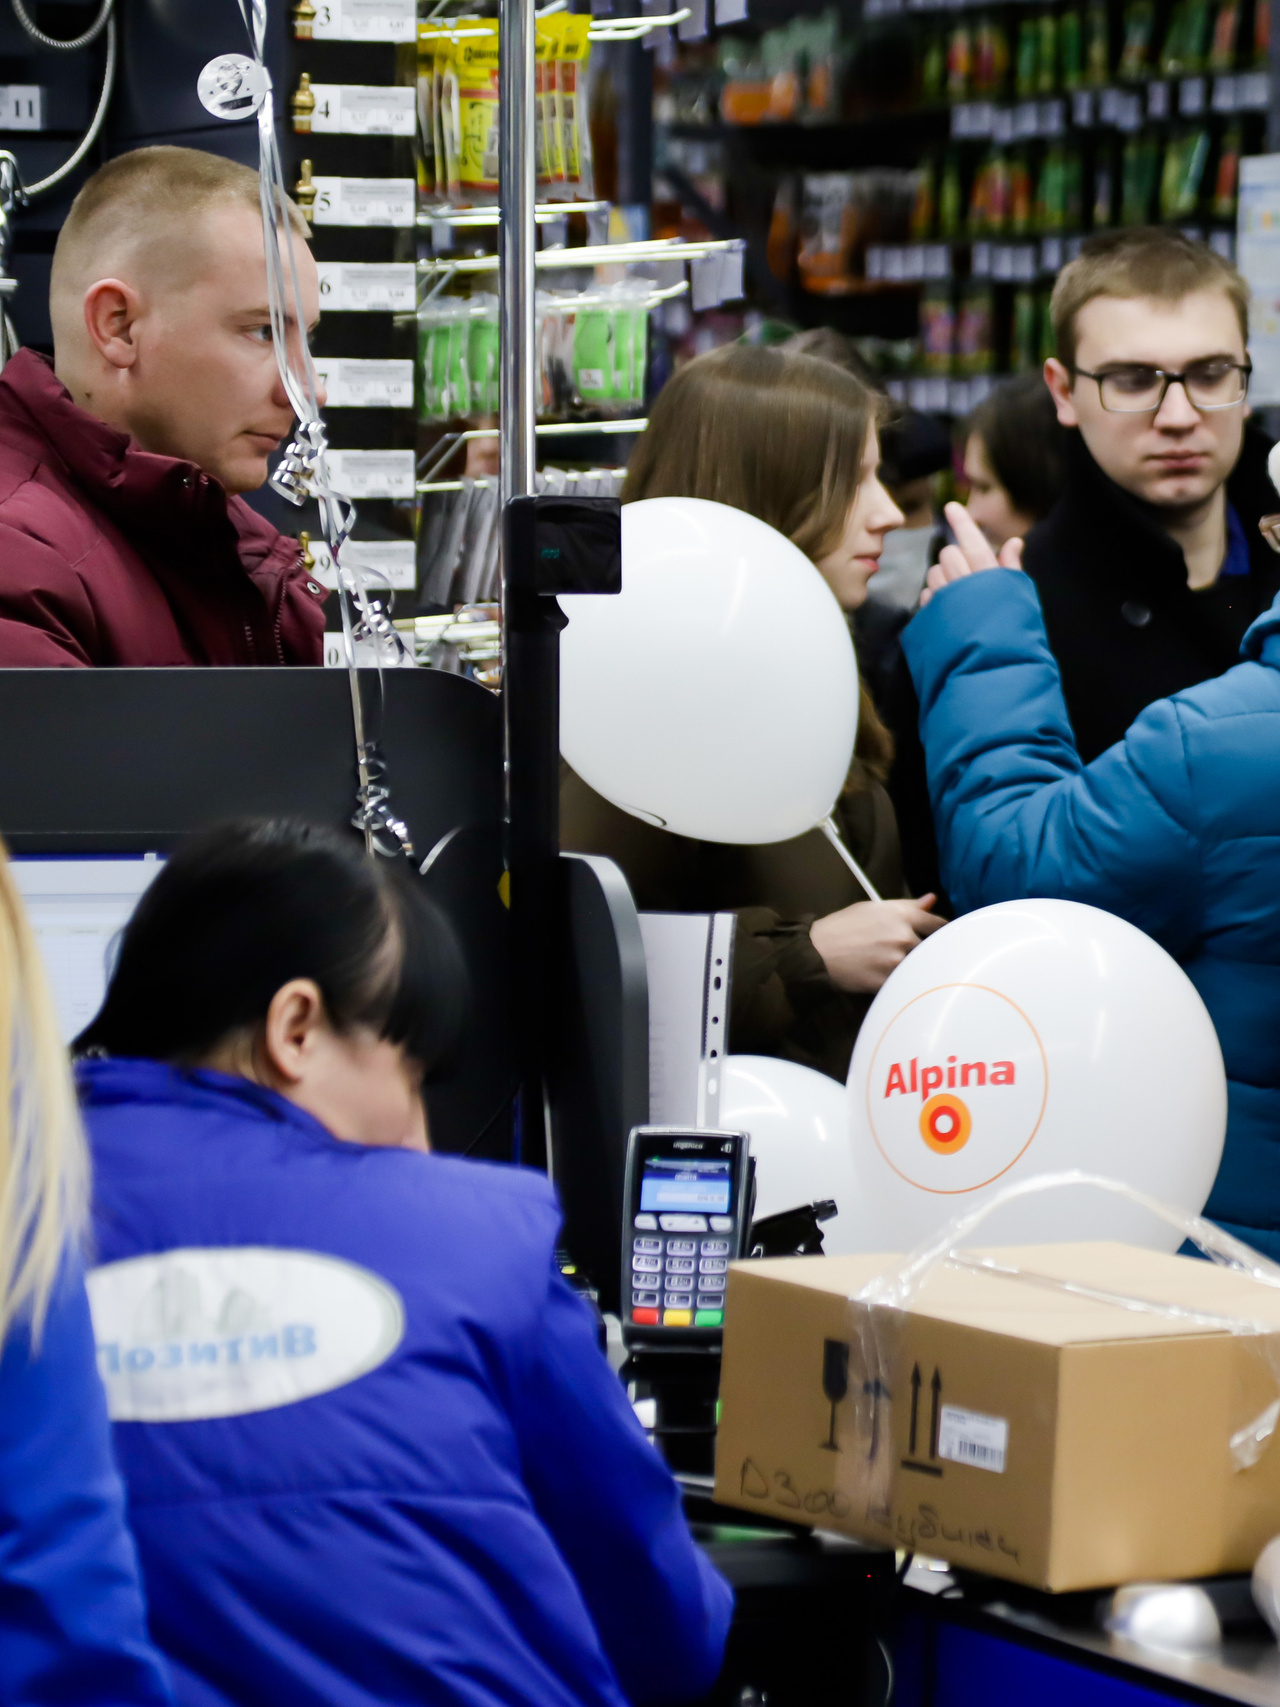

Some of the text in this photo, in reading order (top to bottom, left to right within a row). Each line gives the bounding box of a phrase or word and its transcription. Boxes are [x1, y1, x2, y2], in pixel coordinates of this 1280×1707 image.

[318, 6, 331, 26] 3
[318, 100, 330, 118] 4
[318, 191, 331, 212] 5
[319, 275, 332, 296] 6
[319, 554, 331, 573] 9
[884, 1056, 1015, 1102] Alpina
